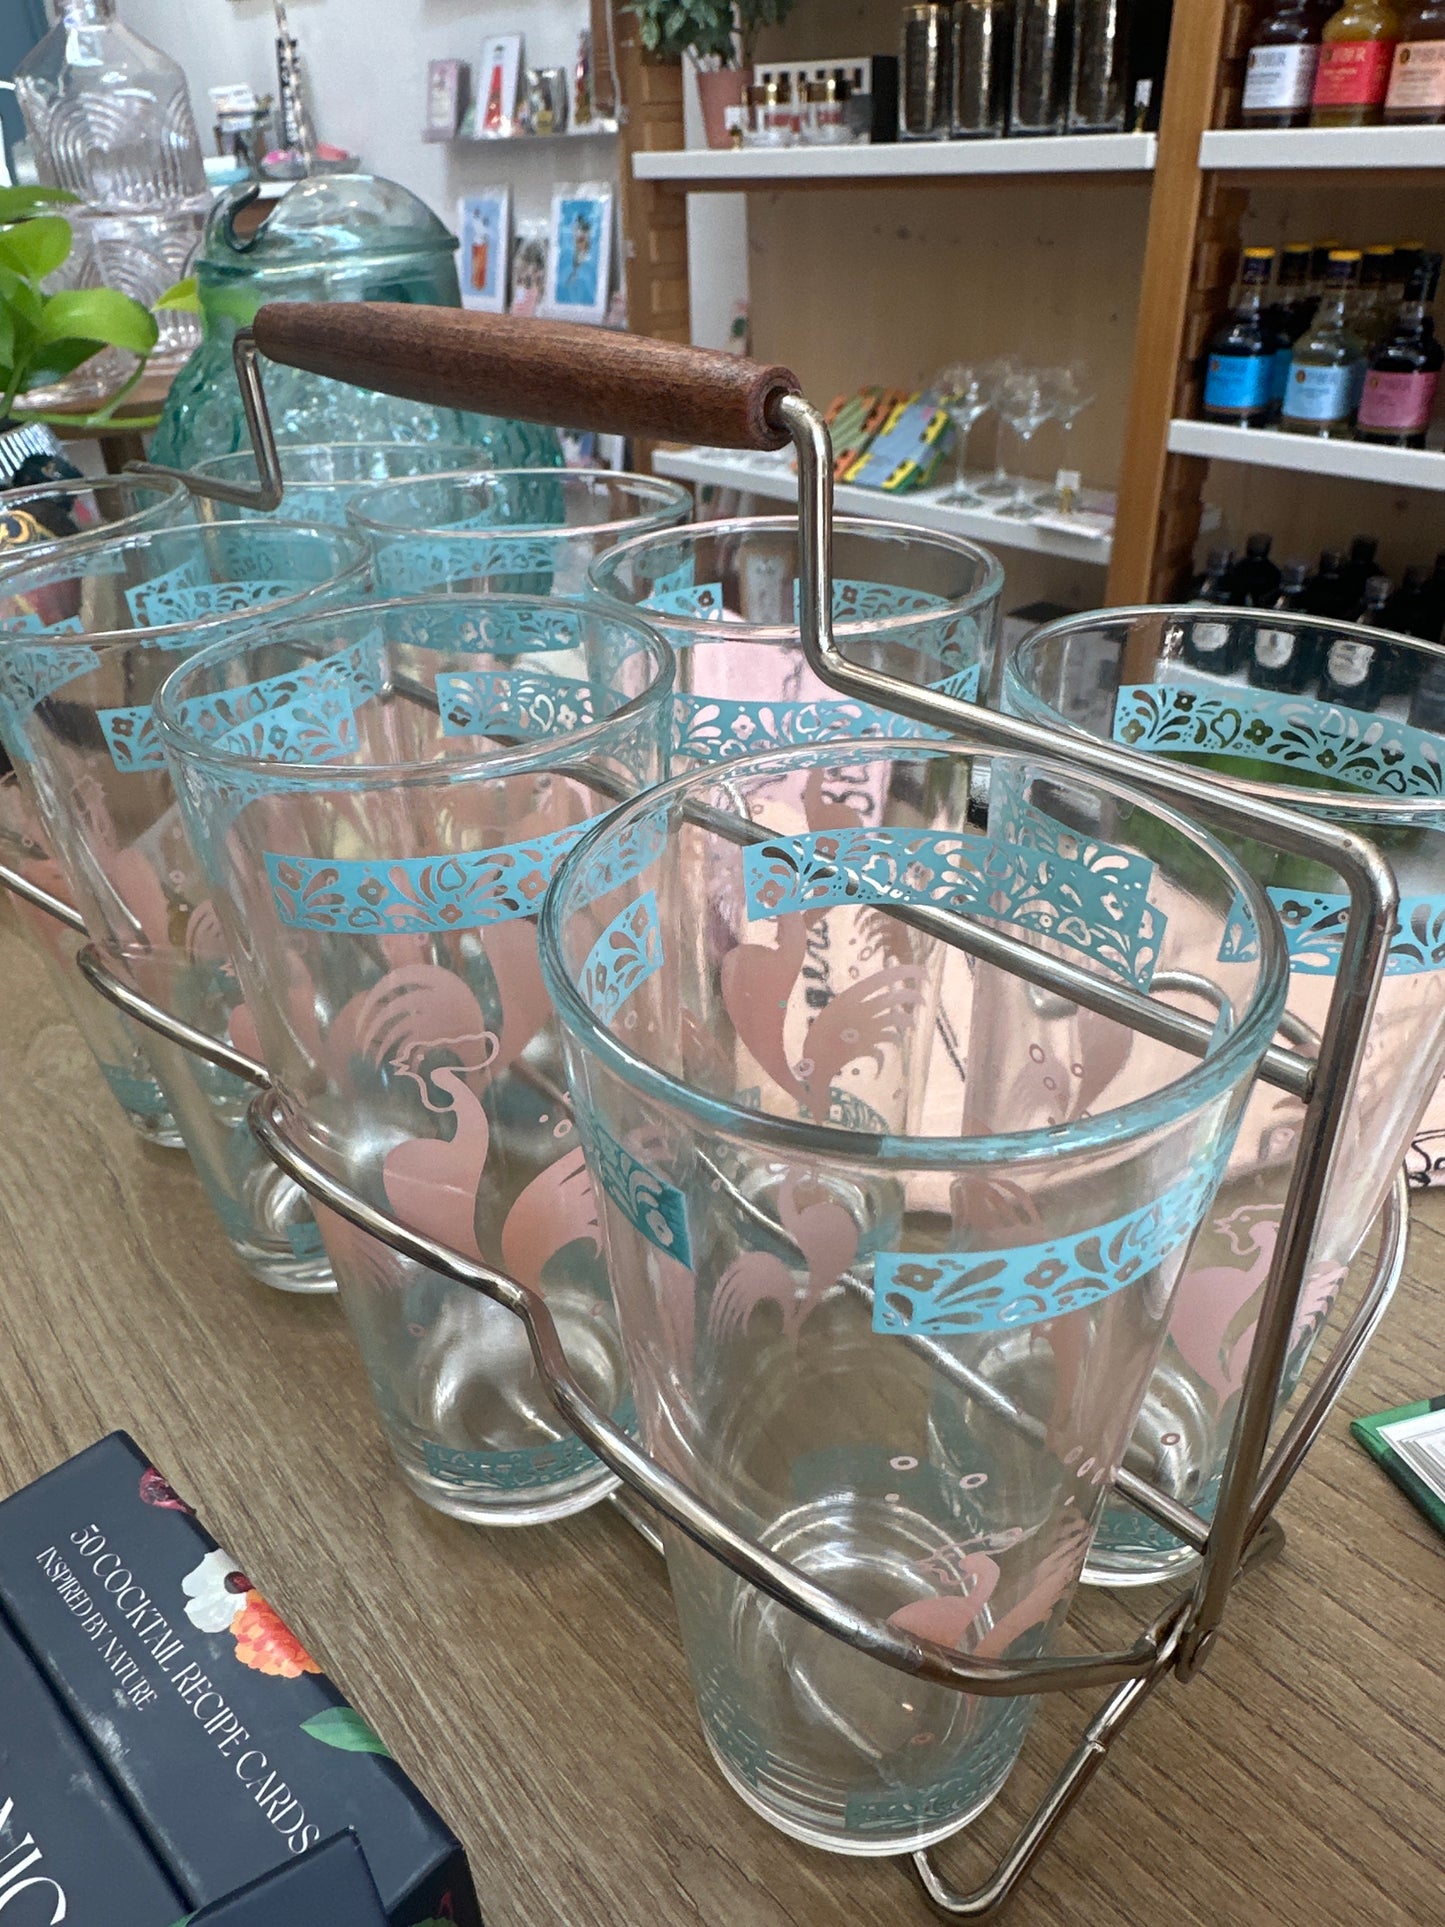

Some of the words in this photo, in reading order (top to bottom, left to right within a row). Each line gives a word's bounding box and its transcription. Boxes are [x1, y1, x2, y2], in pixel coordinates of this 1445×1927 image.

[36, 1546, 94, 1617] INSPIRED
[81, 1612, 113, 1641] BY
[98, 1636, 158, 1711] NATURE
[70, 1524, 106, 1557] 50
[93, 1553, 185, 1672] COCKTAIL
[171, 1661, 250, 1757] RECIPE
[236, 1750, 320, 1854] CARDS
